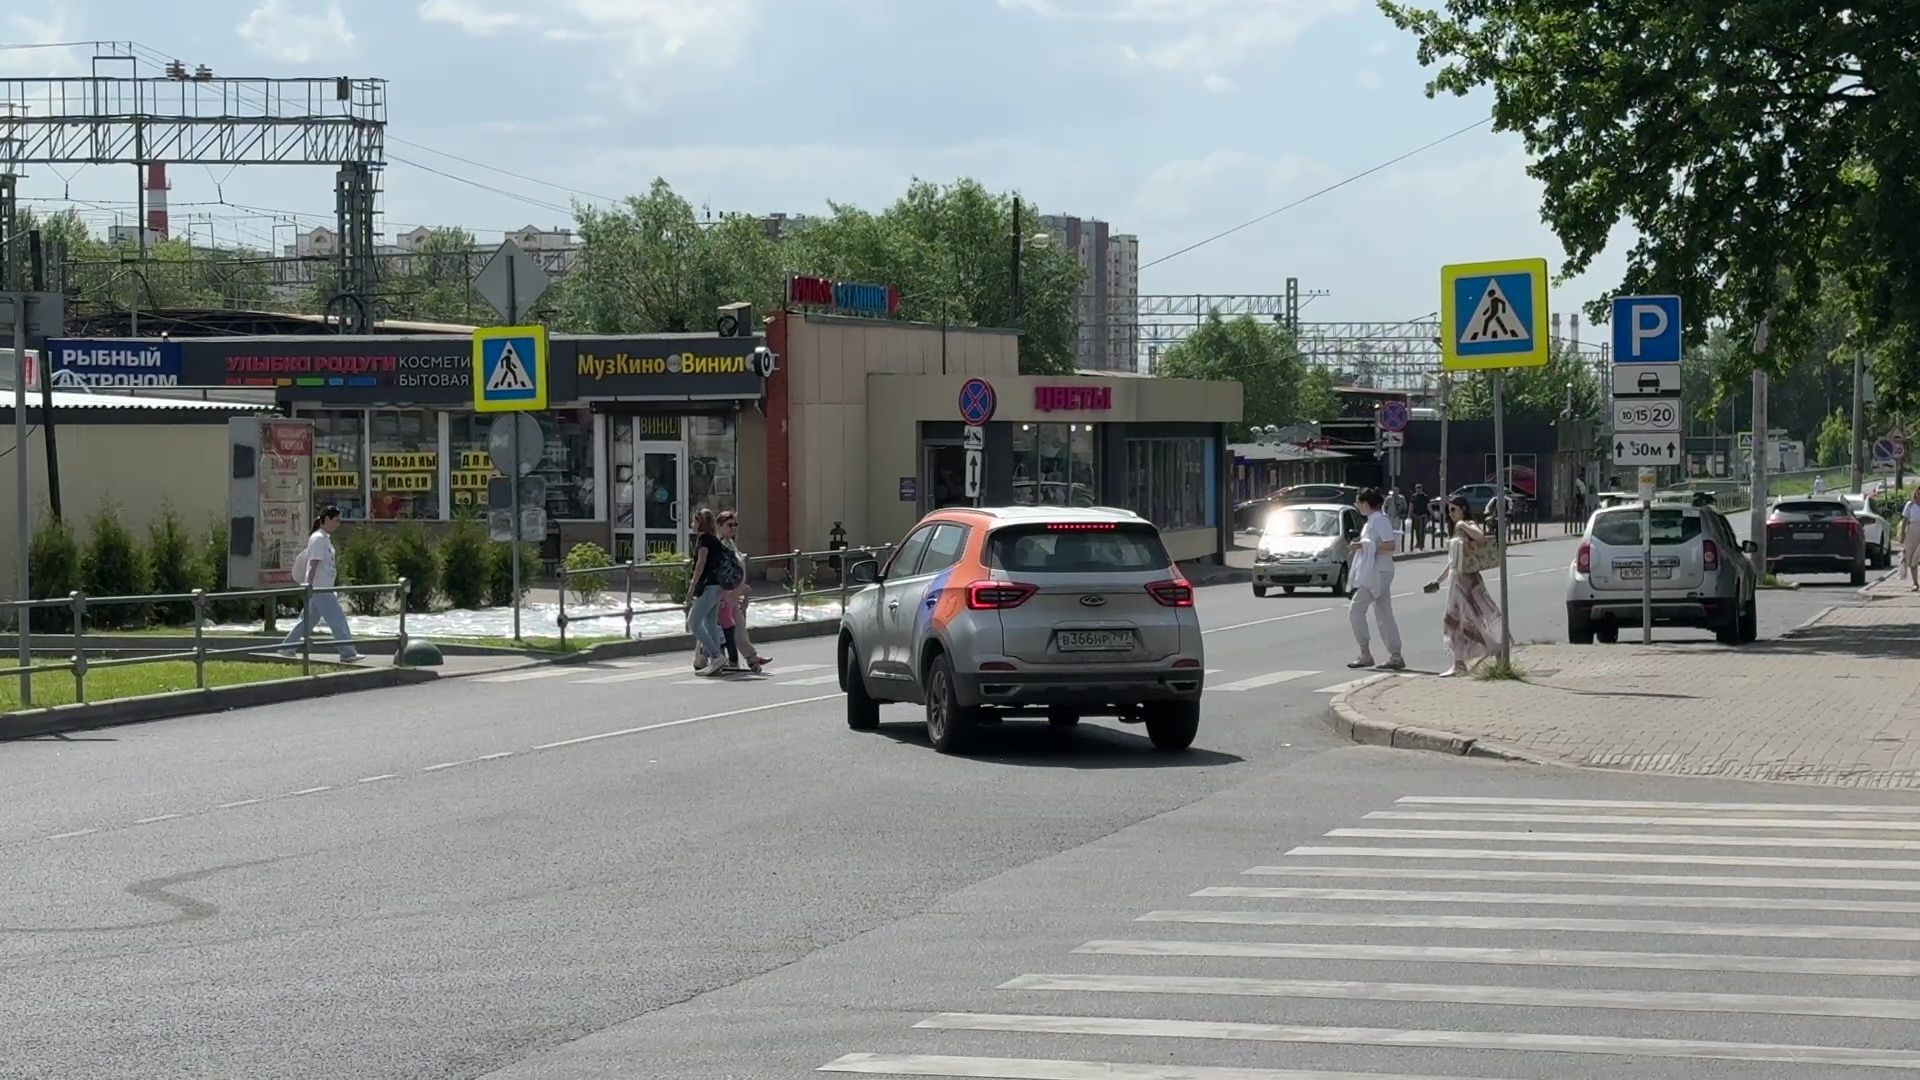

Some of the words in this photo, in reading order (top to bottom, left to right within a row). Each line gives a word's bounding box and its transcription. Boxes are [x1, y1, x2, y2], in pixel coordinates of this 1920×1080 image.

[1631, 304, 1669, 357] P
[62, 347, 161, 367] РЫБНЫЙ
[400, 355, 471, 369] КОСМЕТИ
[225, 356, 311, 372] УЛЫБКА
[314, 356, 397, 374] РАДУГИ
[578, 353, 665, 380] МузКино
[681, 352, 745, 374] Винил
[58, 373, 178, 387] АСТРОНОМ
[400, 373, 470, 387] БЫТОВАЯ
[1035, 386, 1112, 412] ЦВЕТЫ
[1622, 411, 1632, 420] 10
[1636, 409, 1648, 421] 15
[1652, 408, 1672, 422] 20
[313, 475, 357, 487] МПУНИ,
[452, 474, 497, 486] ВОЛО
